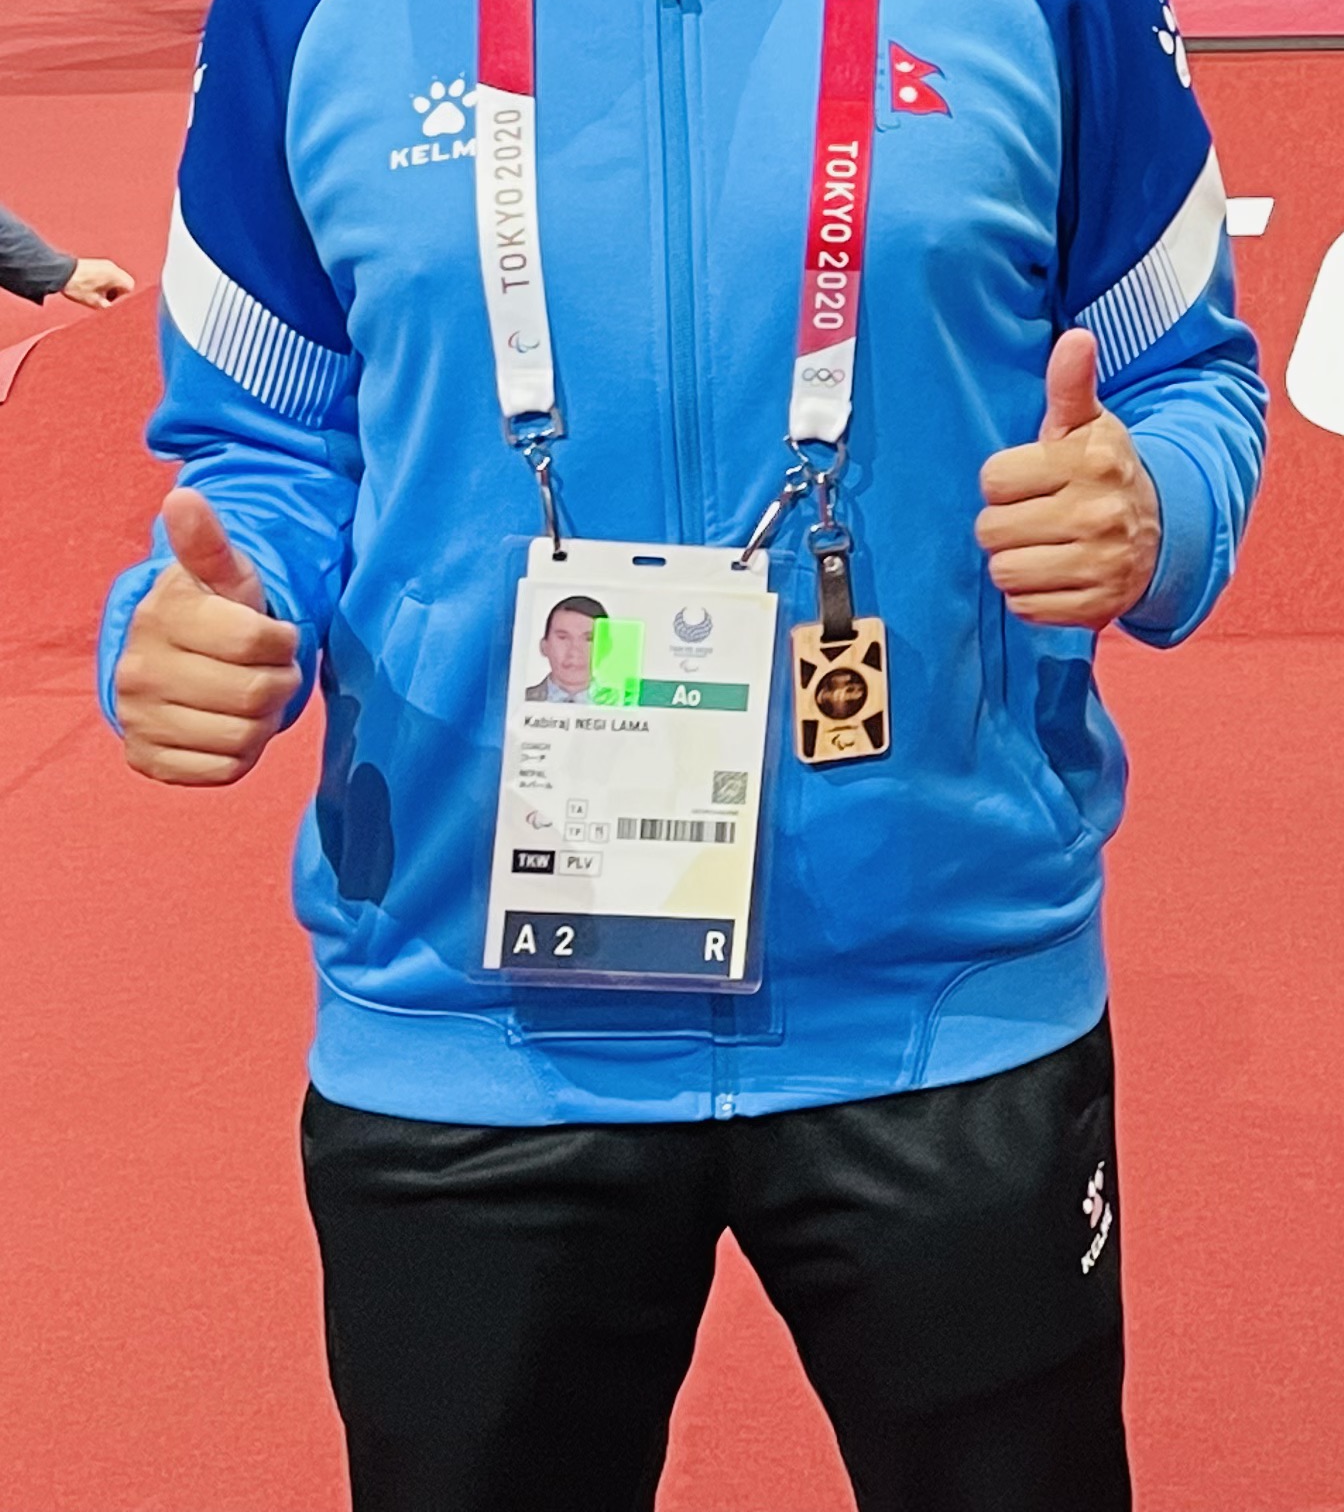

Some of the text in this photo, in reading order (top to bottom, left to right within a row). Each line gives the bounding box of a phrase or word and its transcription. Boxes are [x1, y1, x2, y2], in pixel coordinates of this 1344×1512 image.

[390, 138, 477, 171] KELM
[493, 108, 531, 294] TOKYO 2020
[812, 141, 859, 330] TOKYO 2020
[671, 684, 701, 707] Ao
[575, 718, 606, 730] NEGI
[611, 719, 650, 732] LAMA
[567, 856, 594, 870] PLV
[513, 925, 727, 962] A 2 R
